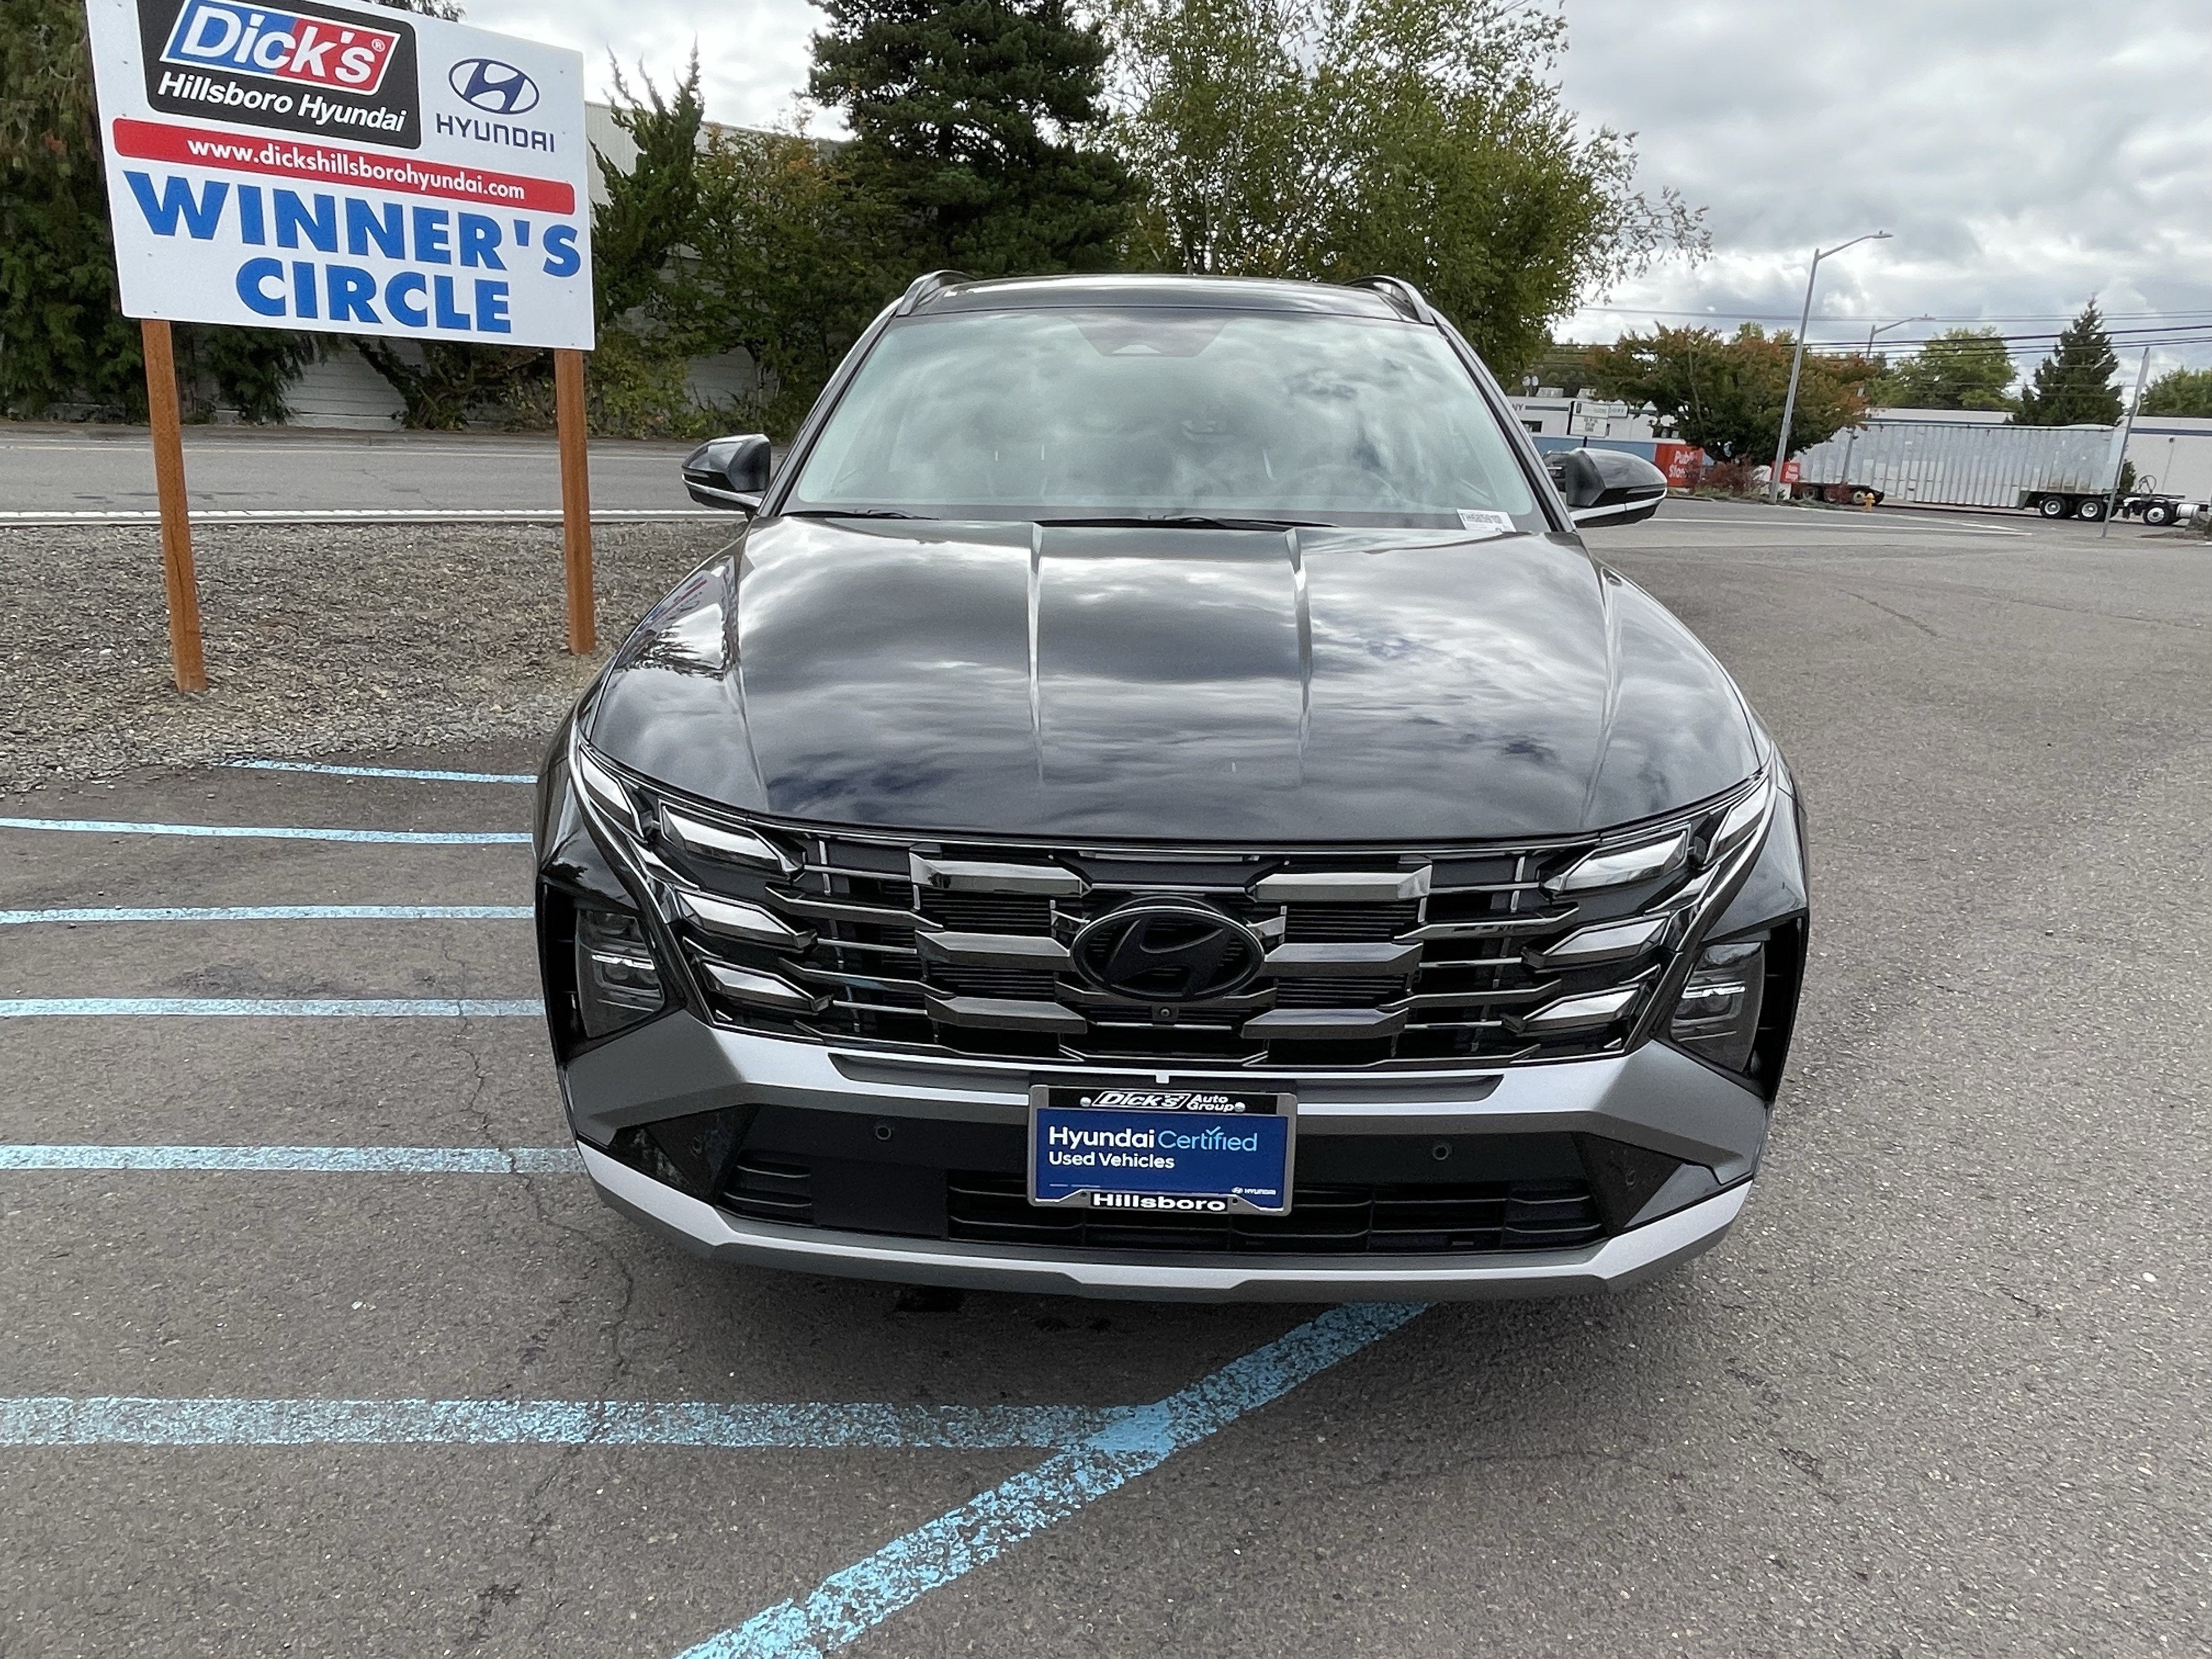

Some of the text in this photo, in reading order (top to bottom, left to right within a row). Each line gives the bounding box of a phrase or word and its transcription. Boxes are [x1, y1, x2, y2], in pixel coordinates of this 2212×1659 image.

[157, 71, 407, 132] Hillsboro Hyundai
[436, 113, 555, 153] HYUNDAI
[188, 139, 525, 200] www.dickshillsborohyundai.com
[123, 171, 581, 278] WINNER'S
[235, 257, 511, 334] CIRCLE
[1187, 1102, 1234, 1112] Group
[1194, 1094, 1229, 1104] Auto
[1049, 1126, 1257, 1152] Hyundai Certified
[1049, 1151, 1175, 1169] Used Vehicles
[1092, 1193, 1226, 1211] Hillsboro
